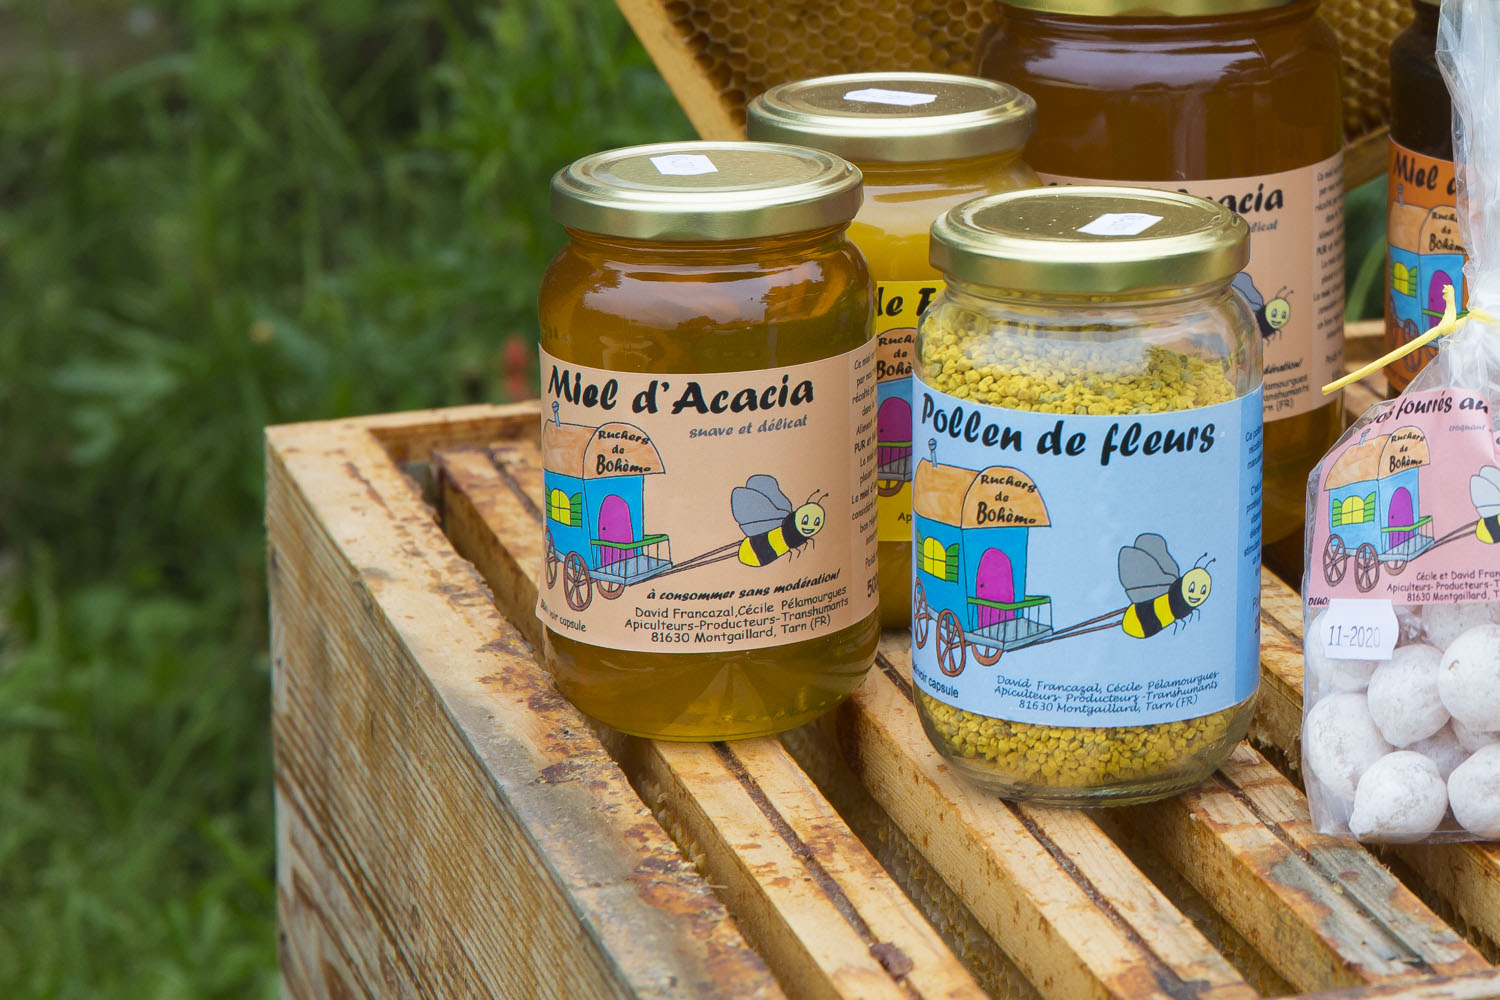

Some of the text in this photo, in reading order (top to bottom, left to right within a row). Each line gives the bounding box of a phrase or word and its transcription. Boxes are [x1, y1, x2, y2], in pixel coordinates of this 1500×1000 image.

[1393, 151, 1439, 191] Miel
[893, 348, 907, 358] de
[548, 365, 619, 410] Miel
[631, 374, 815, 416] d'Acacia
[689, 413, 808, 439] suave et délicat
[922, 392, 1023, 452] Pollen
[1036, 420, 1087, 457] de
[1100, 422, 1216, 467] fleurs
[598, 429, 651, 446] Ruchers
[612, 444, 625, 454] de
[1400, 445, 1409, 453] de
[596, 453, 651, 475] Bohème
[1389, 455, 1423, 473] Bohème
[980, 473, 1037, 494] Ruchers
[995, 491, 1009, 502] de
[976, 501, 1037, 525] Bohème
[647, 568, 841, 601] à consommer sans modération!
[1416, 571, 1438, 582] Cécile
[1439, 571, 1449, 581] et
[1450, 569, 1476, 581] David
[635, 606, 669, 619] David
[781, 586, 847, 610] Pélamourgues
[1407, 593, 1431, 602] 81630
[1432, 590, 1490, 603] Montgaillard,
[559, 617, 587, 632] capsule
[651, 614, 831, 644] 81630 Montgaillard, Tarn (FR)
[1328, 625, 1381, 648] 11-2020
[928, 677, 959, 698] capsule
[997, 671, 1220, 695] David Francazal, Cécile Pélamourgues
[1018, 694, 1198, 717] 81630 Montgaillard, Tarn (FR)
[1066, 690, 1139, 703] Producteurs
